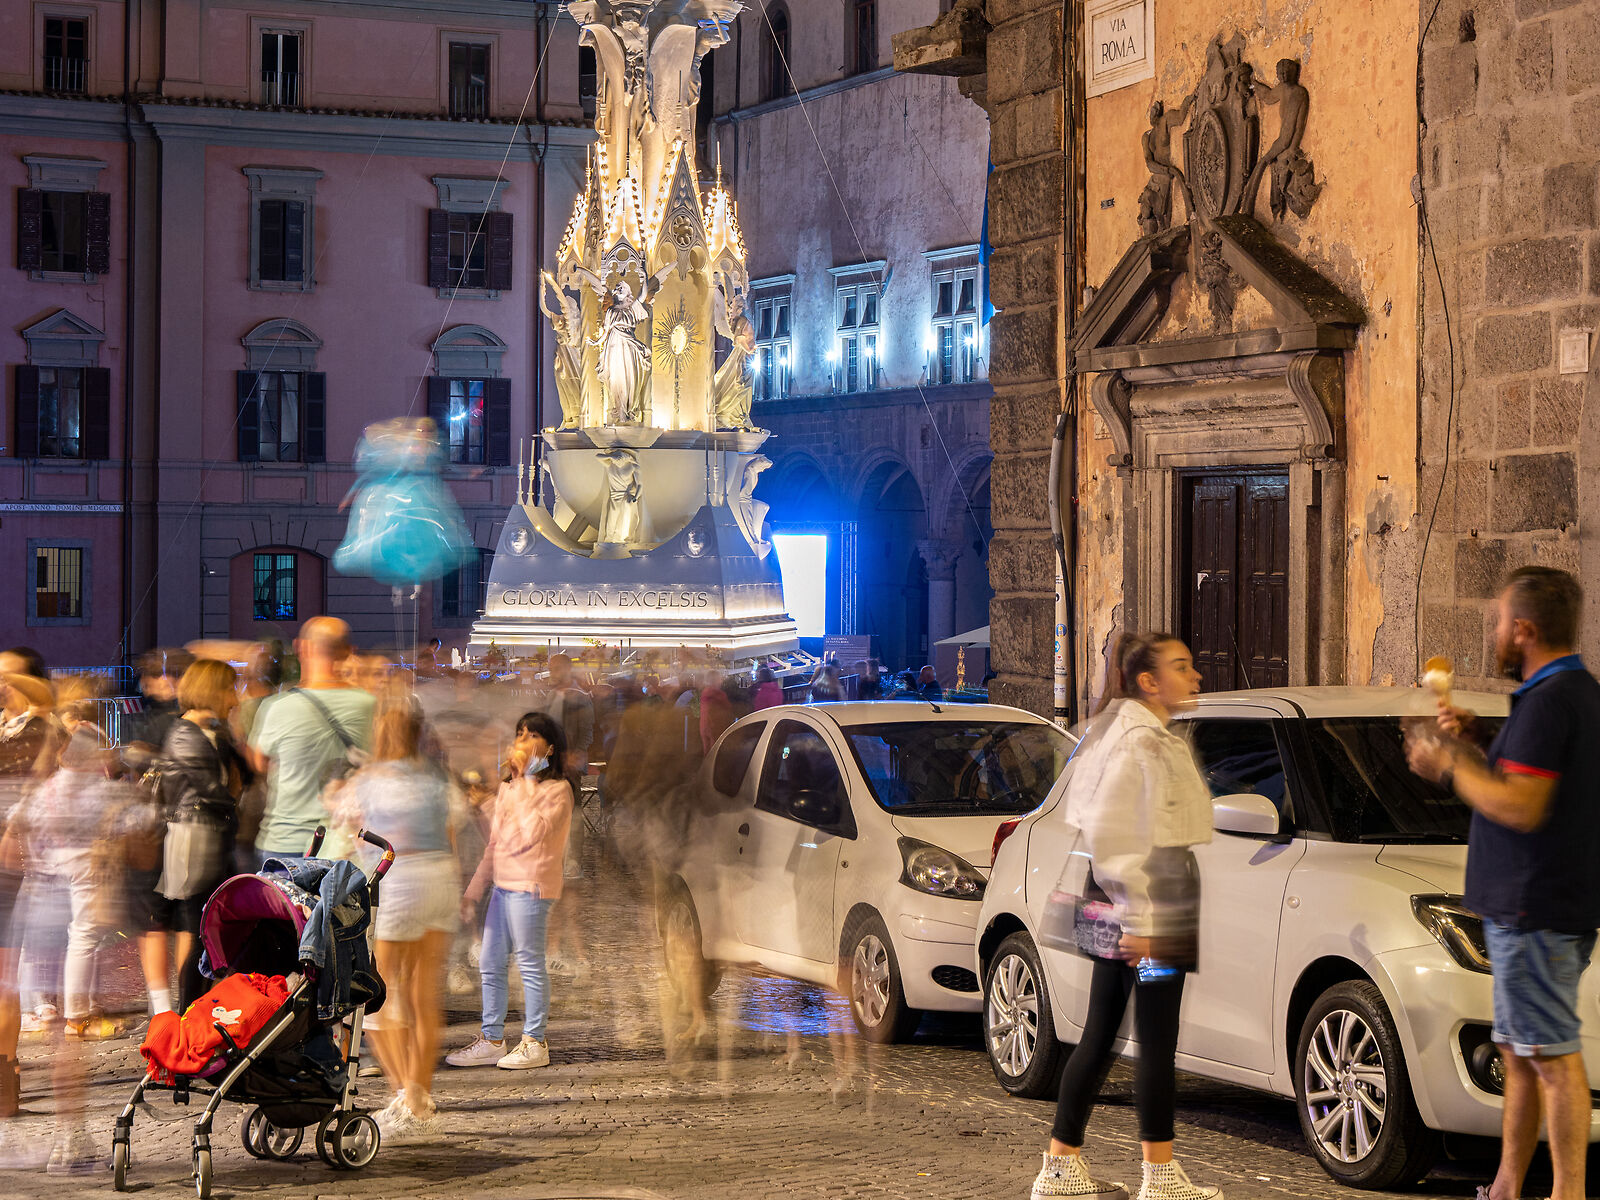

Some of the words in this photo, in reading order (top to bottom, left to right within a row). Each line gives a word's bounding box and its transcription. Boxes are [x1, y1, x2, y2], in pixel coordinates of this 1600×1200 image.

[1110, 18, 1127, 32] VIA
[1101, 36, 1136, 64] ROMA
[502, 589, 578, 606] GLORIA
[587, 590, 610, 606] IN
[618, 591, 708, 608] EXCELSIS
